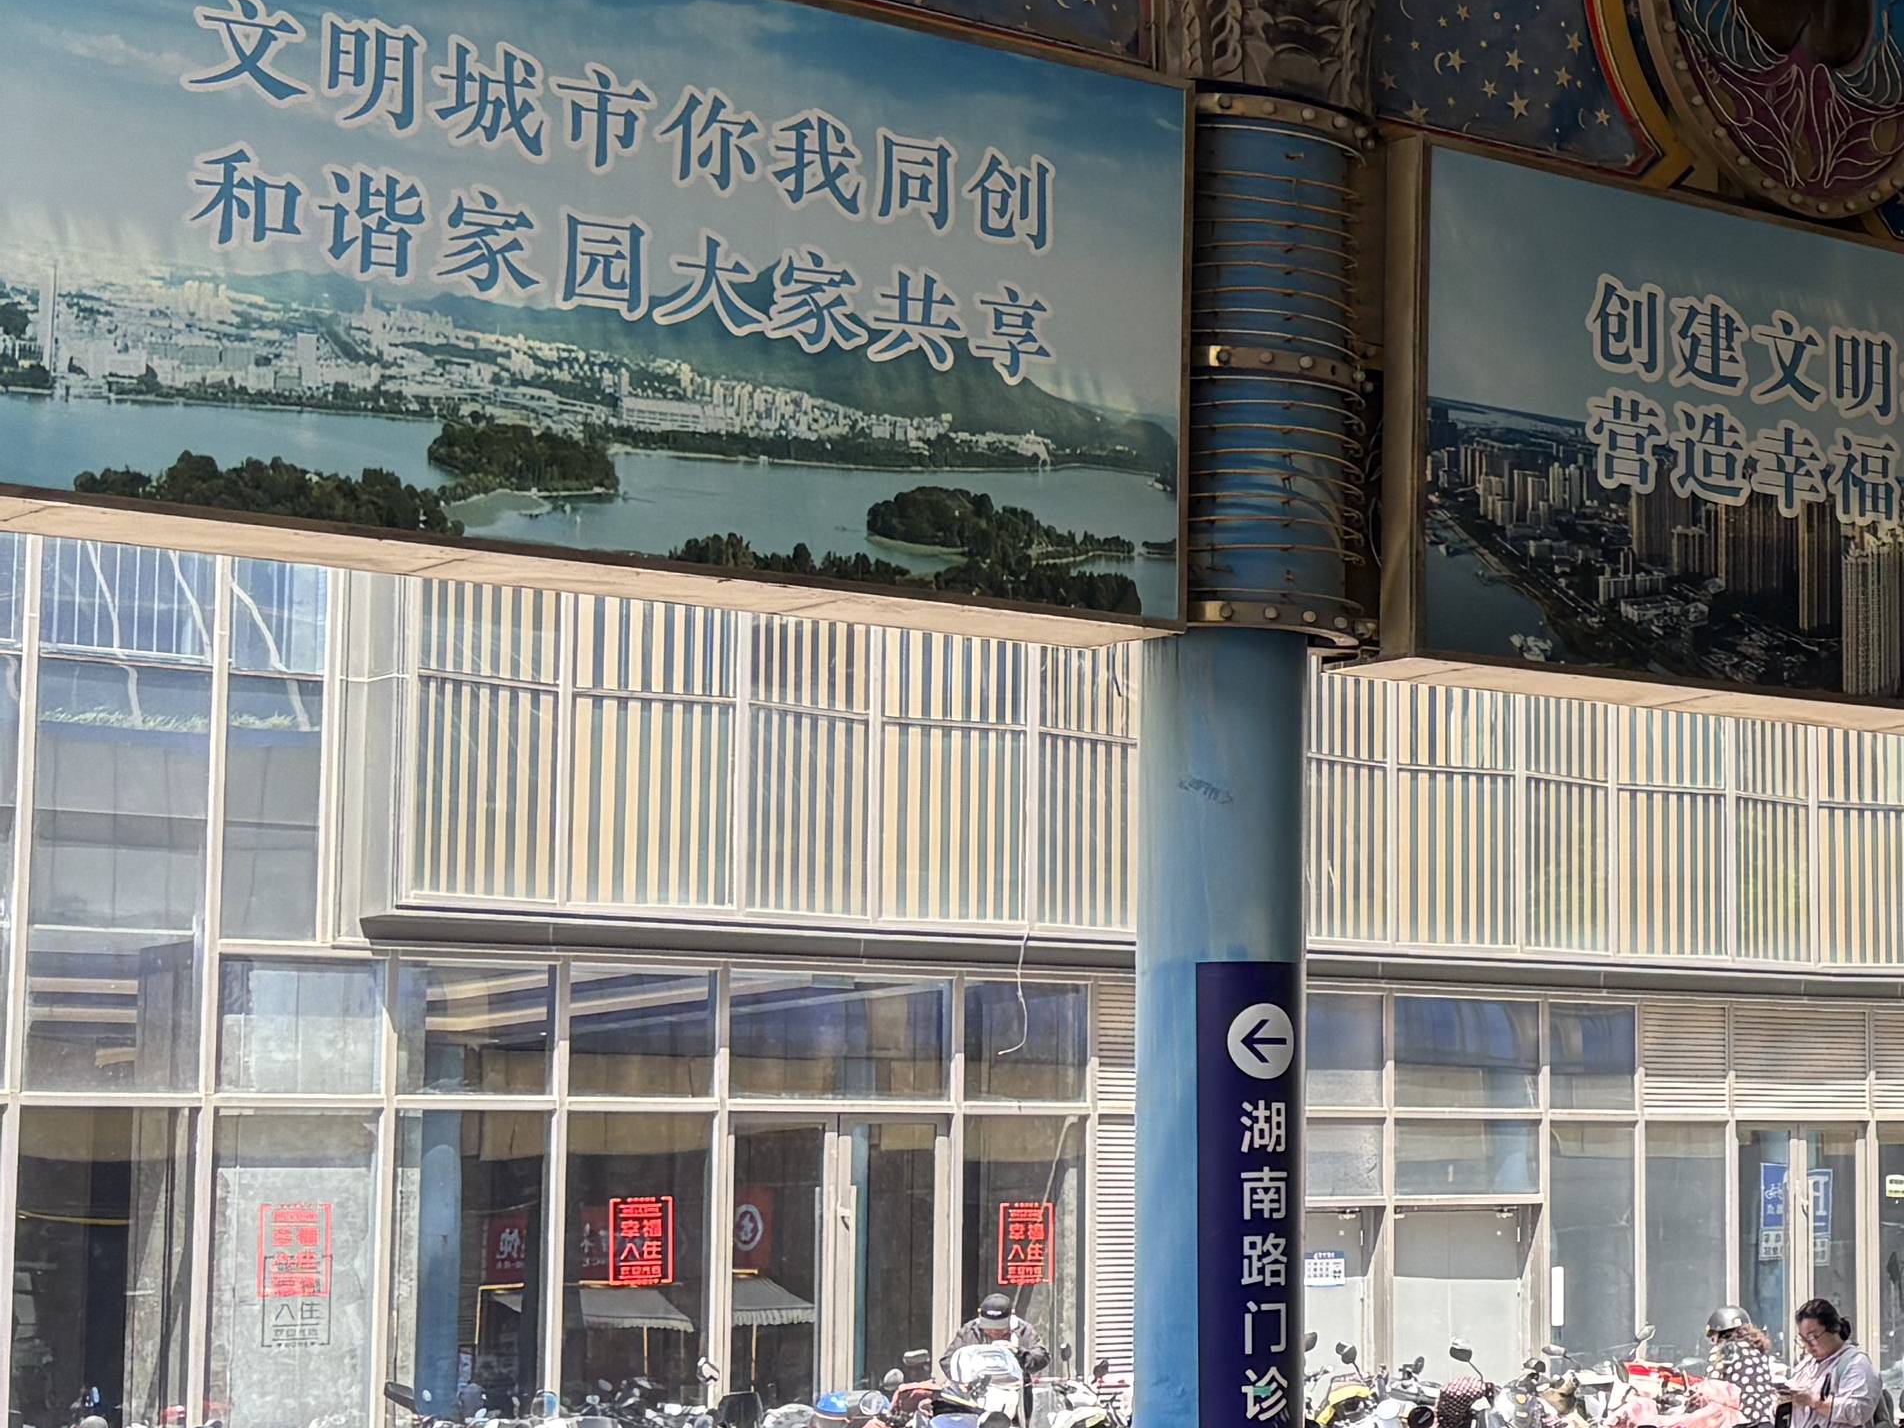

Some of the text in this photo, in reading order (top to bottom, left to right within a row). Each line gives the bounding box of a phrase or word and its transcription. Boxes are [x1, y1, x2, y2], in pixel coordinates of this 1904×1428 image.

[192, 146, 1054, 383] 和谐家园大家共享
[1240, 1100, 1288, 1422] 湖南路门诊
